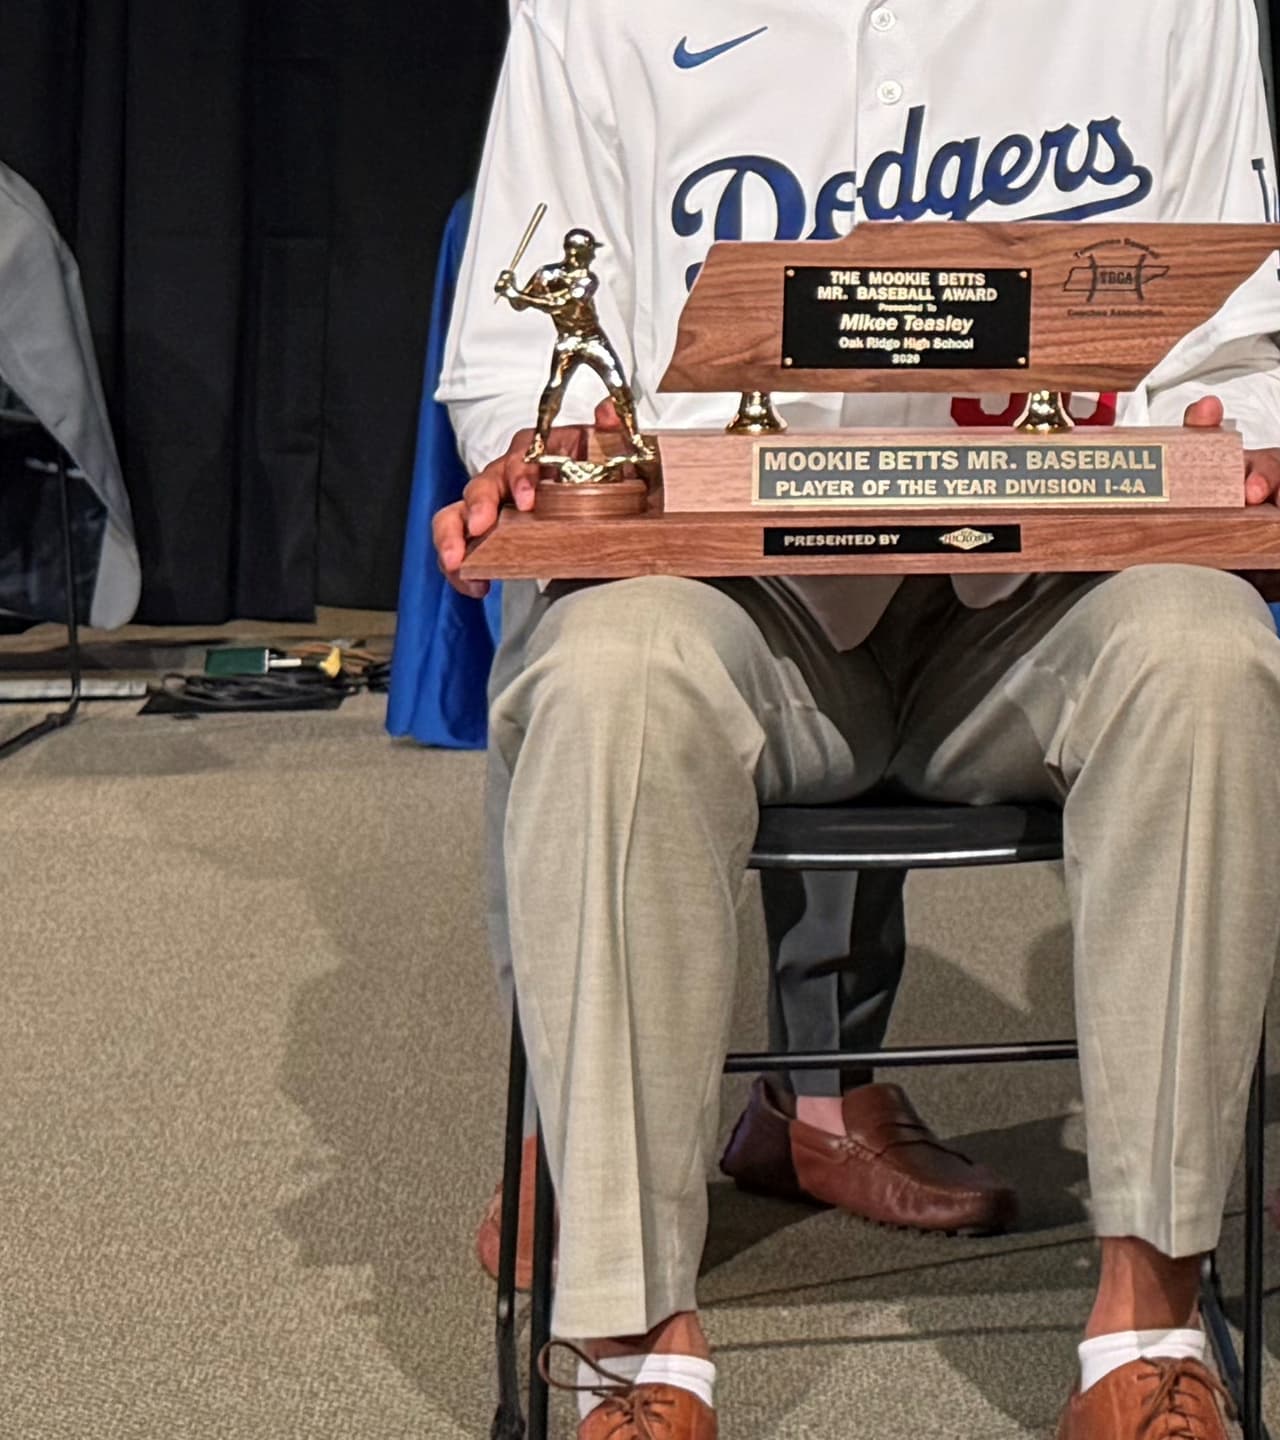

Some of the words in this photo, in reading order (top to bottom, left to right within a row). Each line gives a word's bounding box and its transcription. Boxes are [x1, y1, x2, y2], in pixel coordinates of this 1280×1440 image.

[671, 105, 1152, 241] Dodgers
[831, 272, 860, 285] THE
[869, 272, 930, 285] MOOKIE
[939, 273, 985, 286] BETTS
[817, 286, 848, 299] MR.
[857, 287, 935, 300] BASEBALL
[943, 288, 997, 301] AWARD
[904, 315, 974, 334] Teasley
[839, 337, 863, 348] Oak
[867, 338, 899, 351] Ridge
[904, 338, 930, 351] High
[933, 338, 973, 349] School
[764, 451, 870, 471] MOOKIE
[879, 451, 959, 470] BETTS
[967, 451, 1016, 470] MR.
[1026, 450, 1156, 470] BASEBALL
[776, 481, 853, 496] PLAYER
[863, 480, 890, 495] OF
[897, 480, 936, 495] THE
[944, 479, 996, 495] YEAR
[1006, 478, 1095, 494] DIVISION
[1105, 479, 1146, 494] I-4A
[784, 535, 875, 546] PRESENTED
[879, 534, 901, 546] BY
